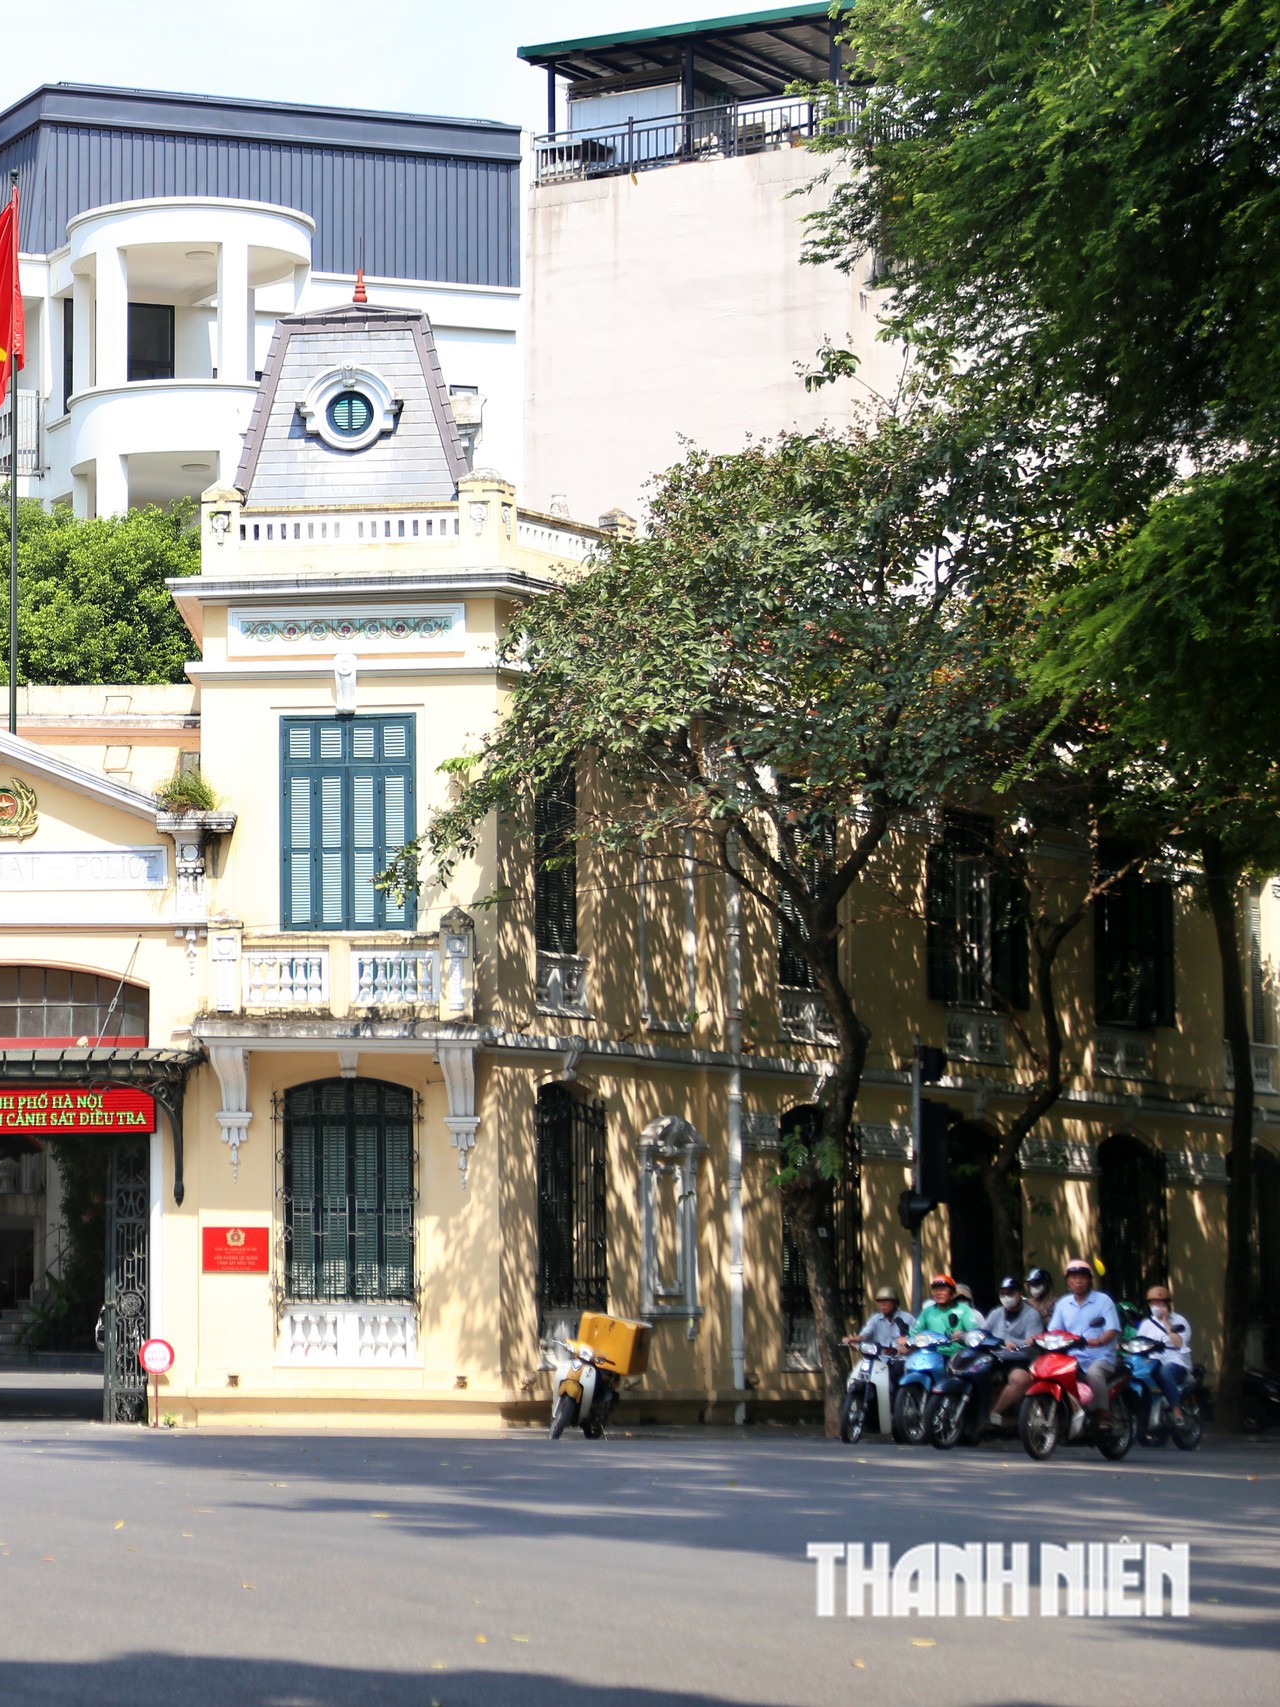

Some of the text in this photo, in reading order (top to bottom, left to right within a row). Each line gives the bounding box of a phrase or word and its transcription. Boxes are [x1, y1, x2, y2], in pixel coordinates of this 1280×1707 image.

[74, 855, 159, 880] POLICE
[18, 1093, 48, 1109] PHỐ
[52, 1094, 74, 1109] HÀ
[76, 1094, 103, 1110] NỘI
[6, 1110, 47, 1126] CẢNH
[50, 1110, 76, 1125] SÁT
[116, 1111, 147, 1125] TRA
